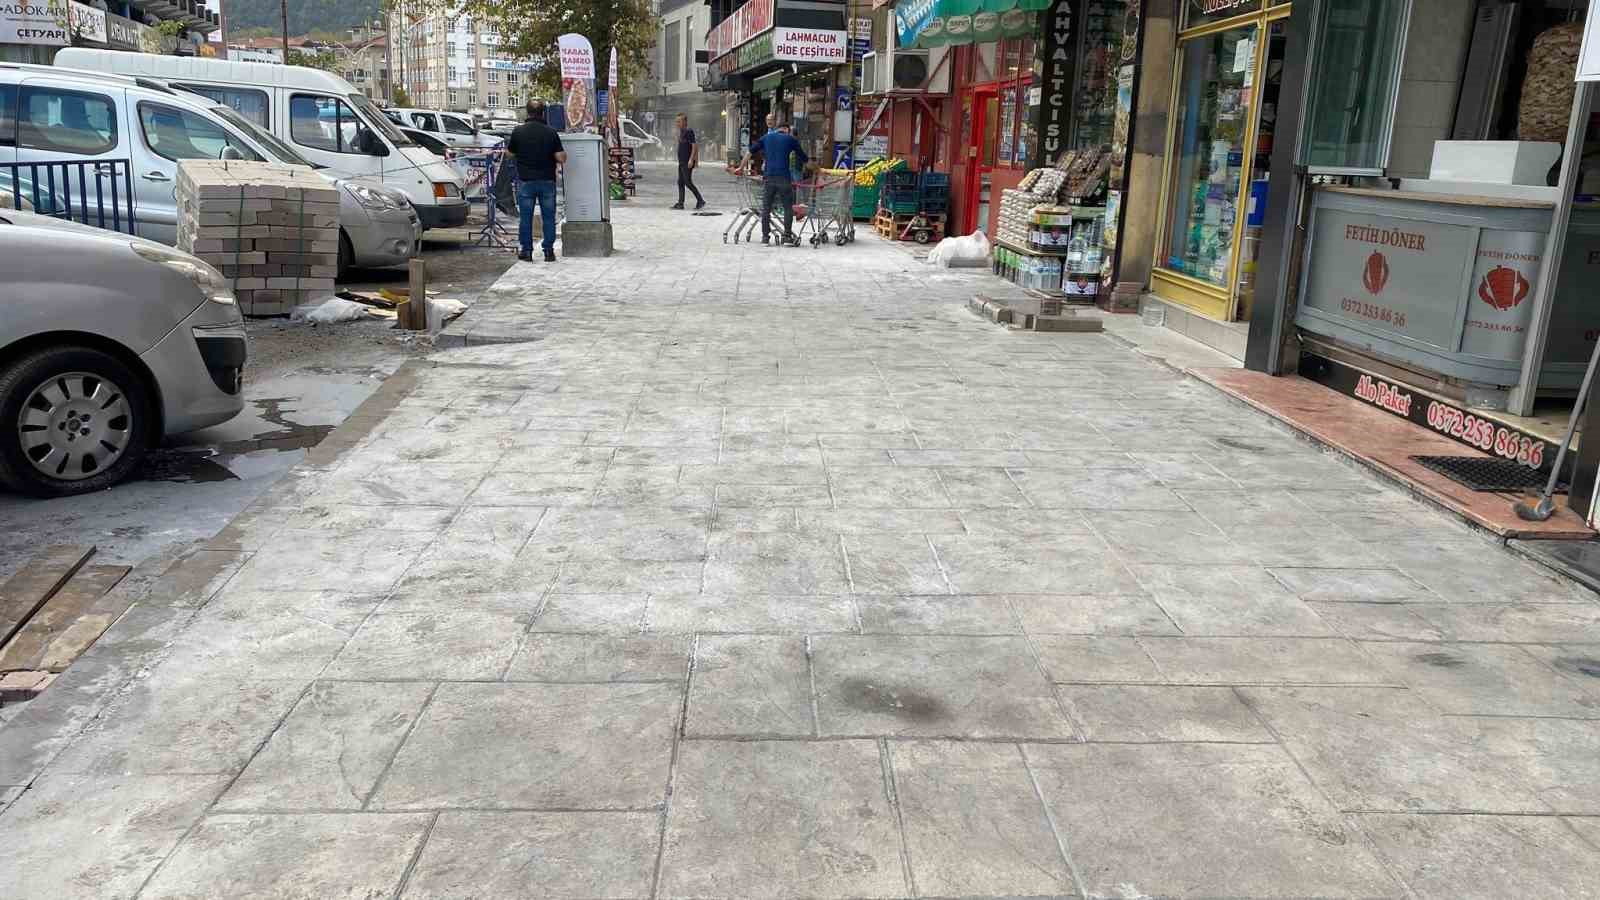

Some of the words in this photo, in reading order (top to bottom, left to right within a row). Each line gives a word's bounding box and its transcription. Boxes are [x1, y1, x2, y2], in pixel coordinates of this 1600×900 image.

[786, 32, 836, 43] LAHMACUN
[777, 44, 797, 55] PİDE
[800, 45, 844, 58] ÇEŞİTLERİ
[1346, 224, 1379, 244] FETİH
[1381, 227, 1425, 251] DÖNER
[1342, 298, 1361, 314] 0372
[1362, 304, 1379, 319] 253
[1354, 374, 1377, 402] Alo
[1376, 381, 1412, 416] Paket
[1427, 401, 1463, 437] 0372
[1462, 415, 1494, 450] 253
[1494, 428, 1520, 459] 86
[1517, 437, 1544, 470] 36
